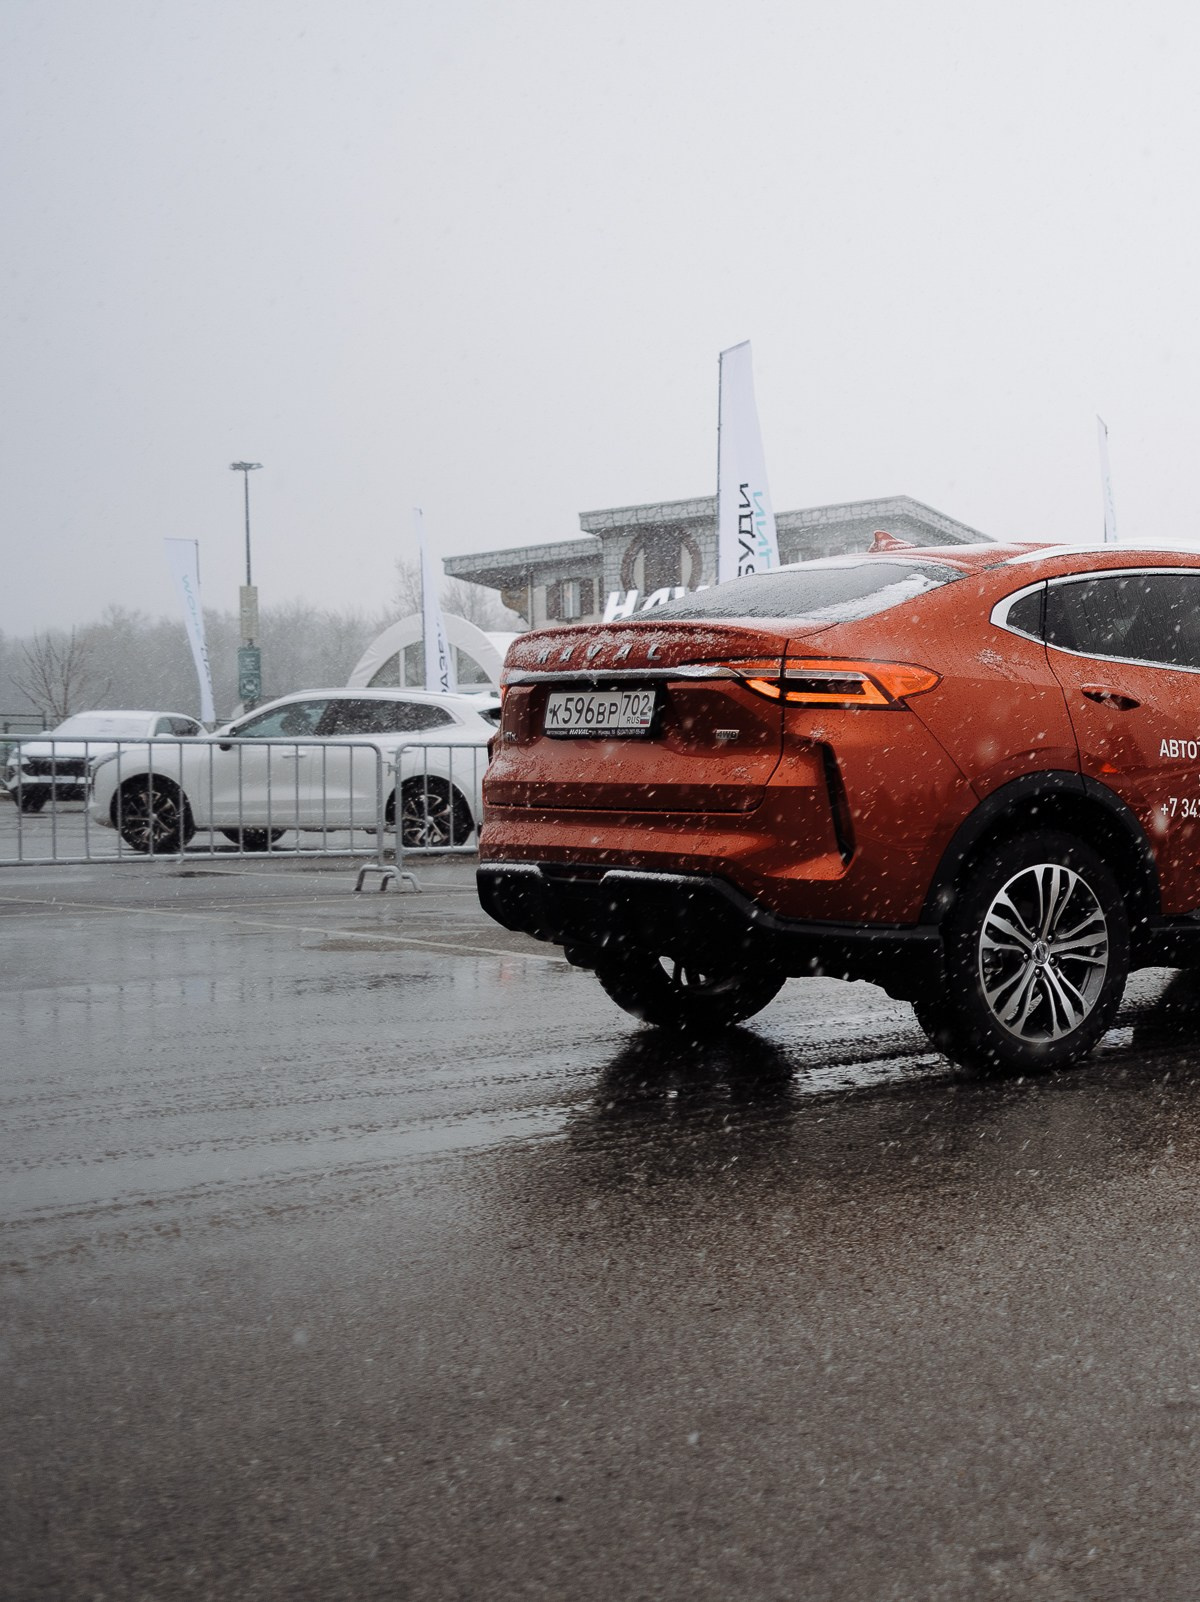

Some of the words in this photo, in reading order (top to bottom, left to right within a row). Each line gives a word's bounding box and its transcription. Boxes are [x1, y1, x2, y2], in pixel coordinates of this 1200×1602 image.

[622, 694, 650, 716] 702
[626, 716, 640, 724] RUS
[1160, 797, 1178, 817] +7
